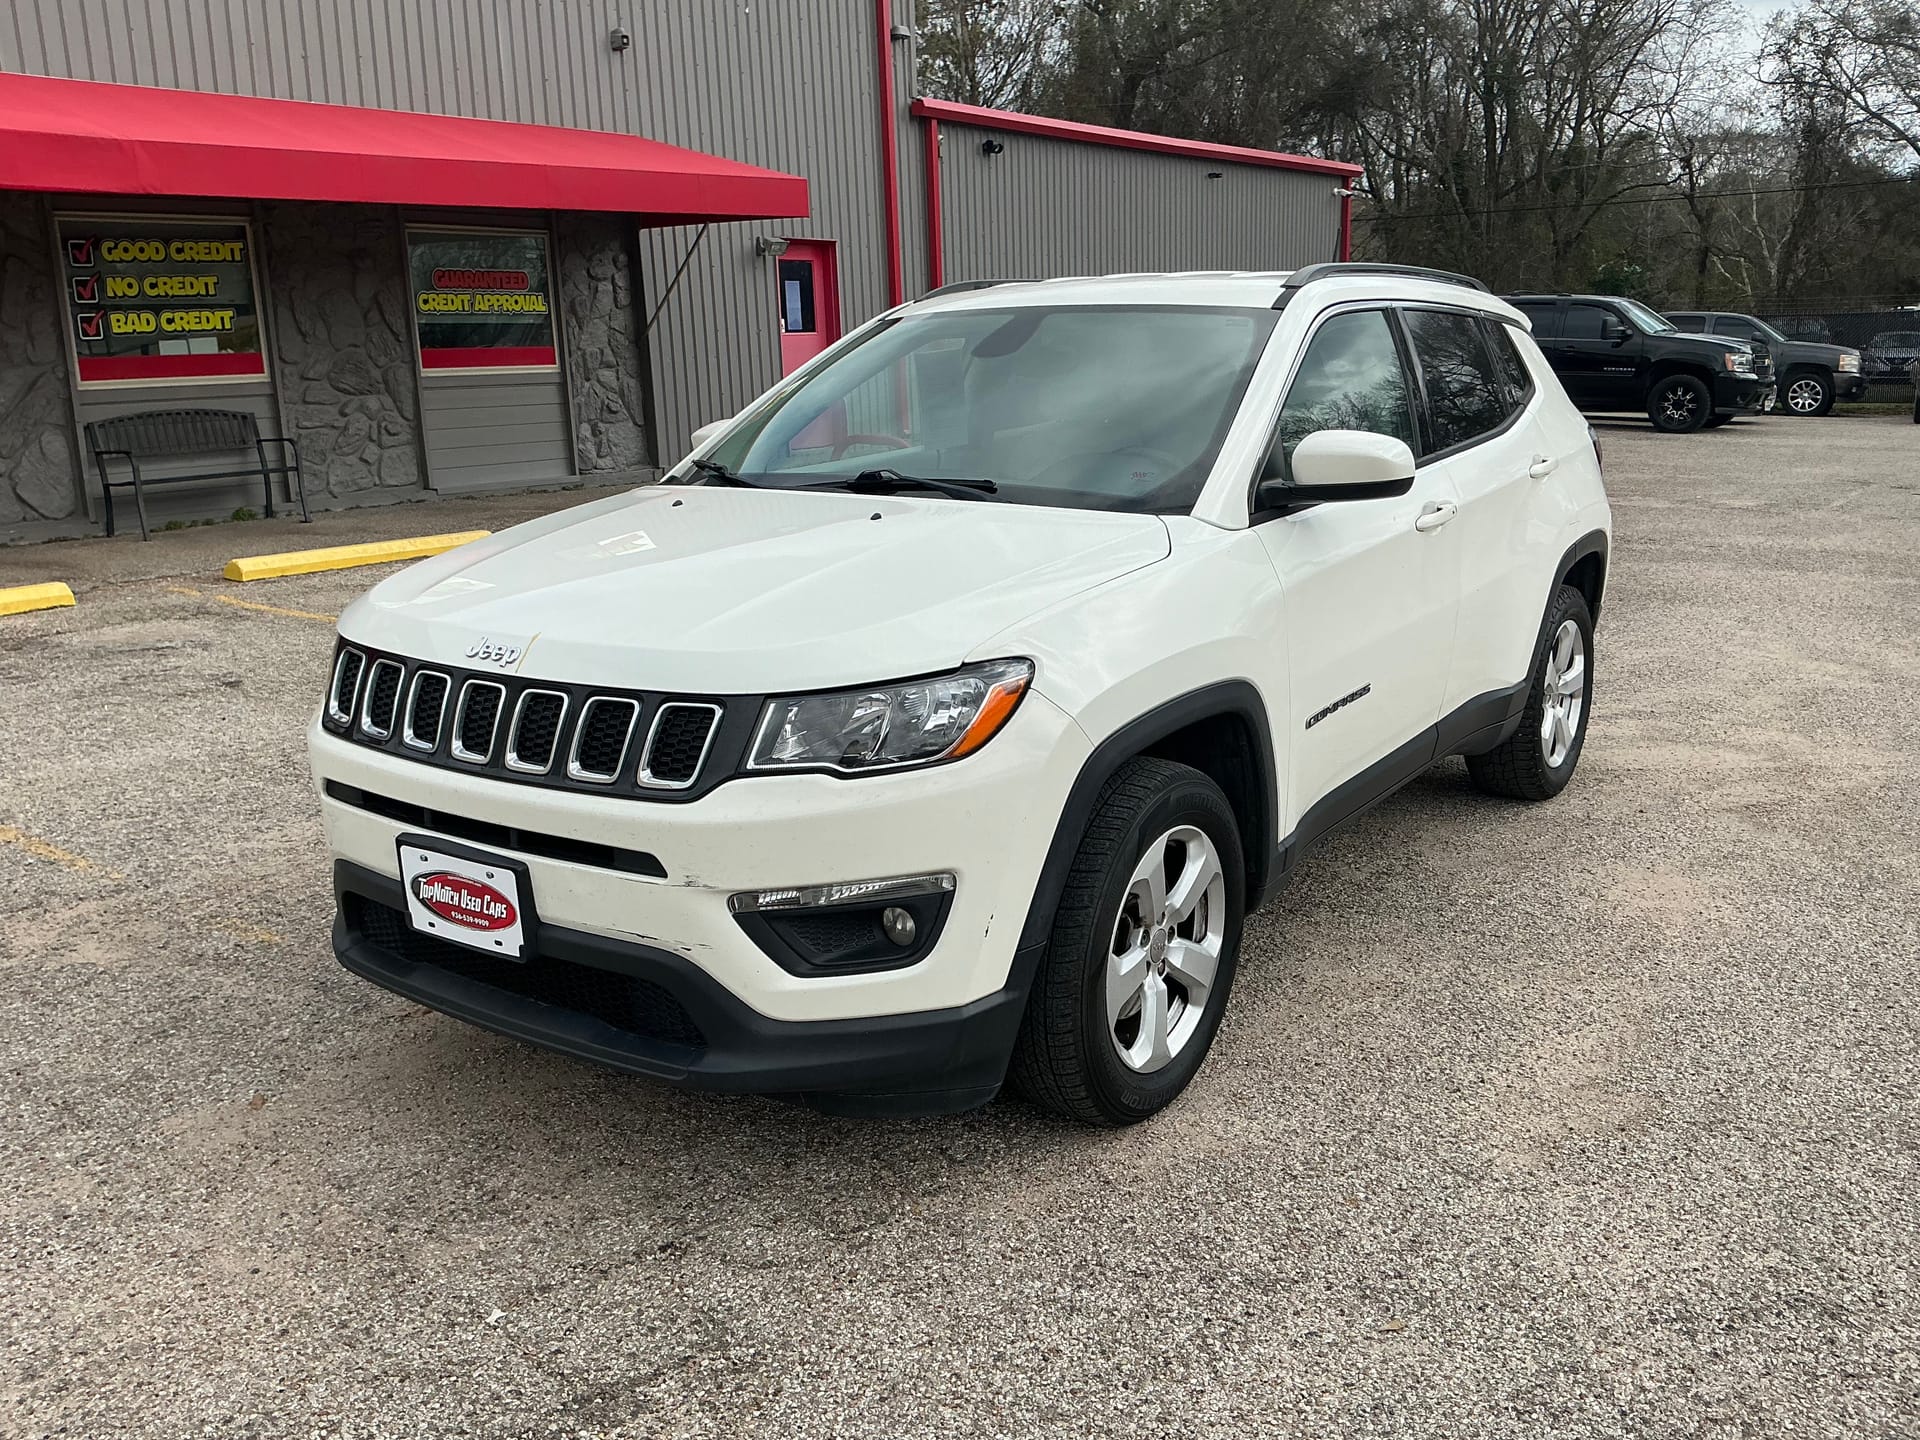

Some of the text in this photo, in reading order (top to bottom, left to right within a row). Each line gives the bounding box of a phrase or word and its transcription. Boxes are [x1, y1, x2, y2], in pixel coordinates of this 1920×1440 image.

[101, 240, 244, 262] GOOD CREDIT
[106, 275, 218, 297] NO CREDIT
[434, 269, 529, 290] GUARANTEED
[418, 293, 547, 312] CREDIT APPROVAL
[109, 310, 234, 334] BAD CREDIT
[464, 636, 521, 668] Jeep
